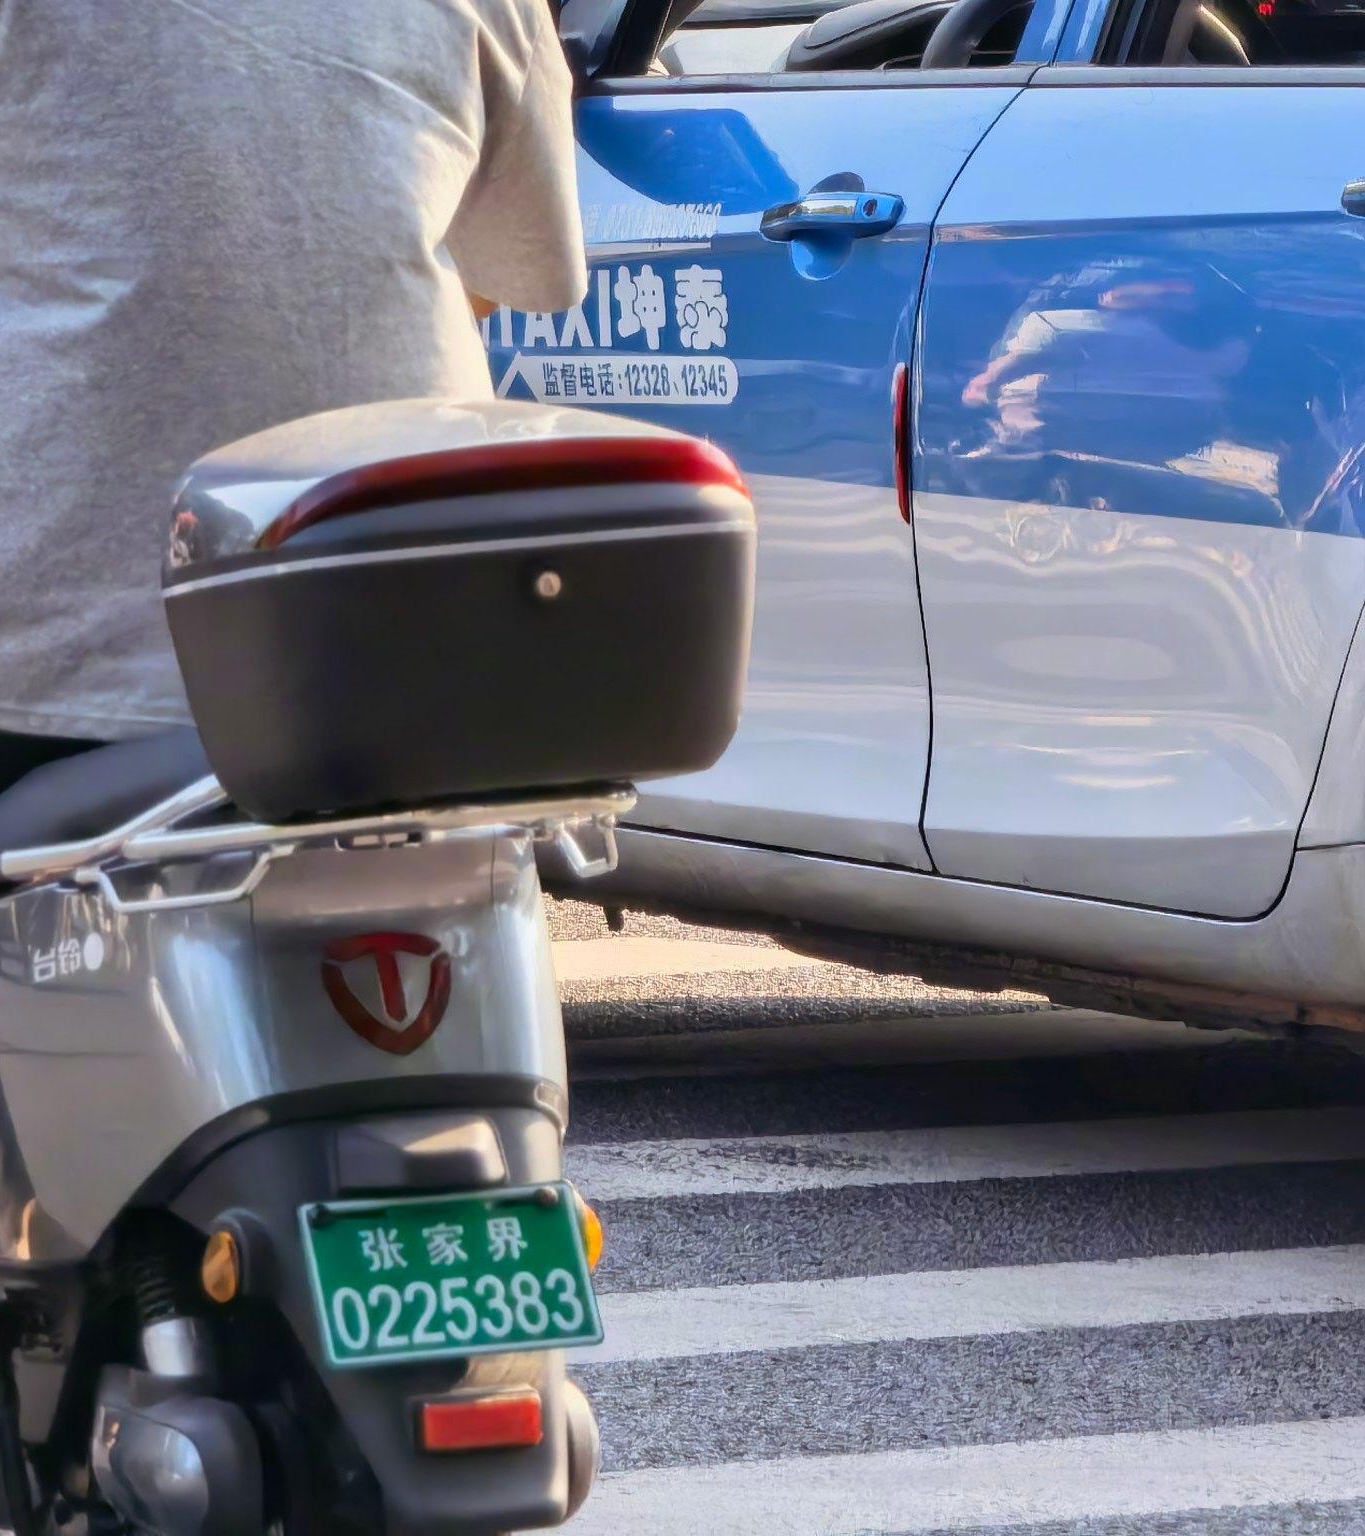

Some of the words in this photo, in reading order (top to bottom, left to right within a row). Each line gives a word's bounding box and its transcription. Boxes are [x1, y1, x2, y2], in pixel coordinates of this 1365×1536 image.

[358, 1216, 528, 1272] 张家界
[332, 1268, 585, 1350] 0225383
